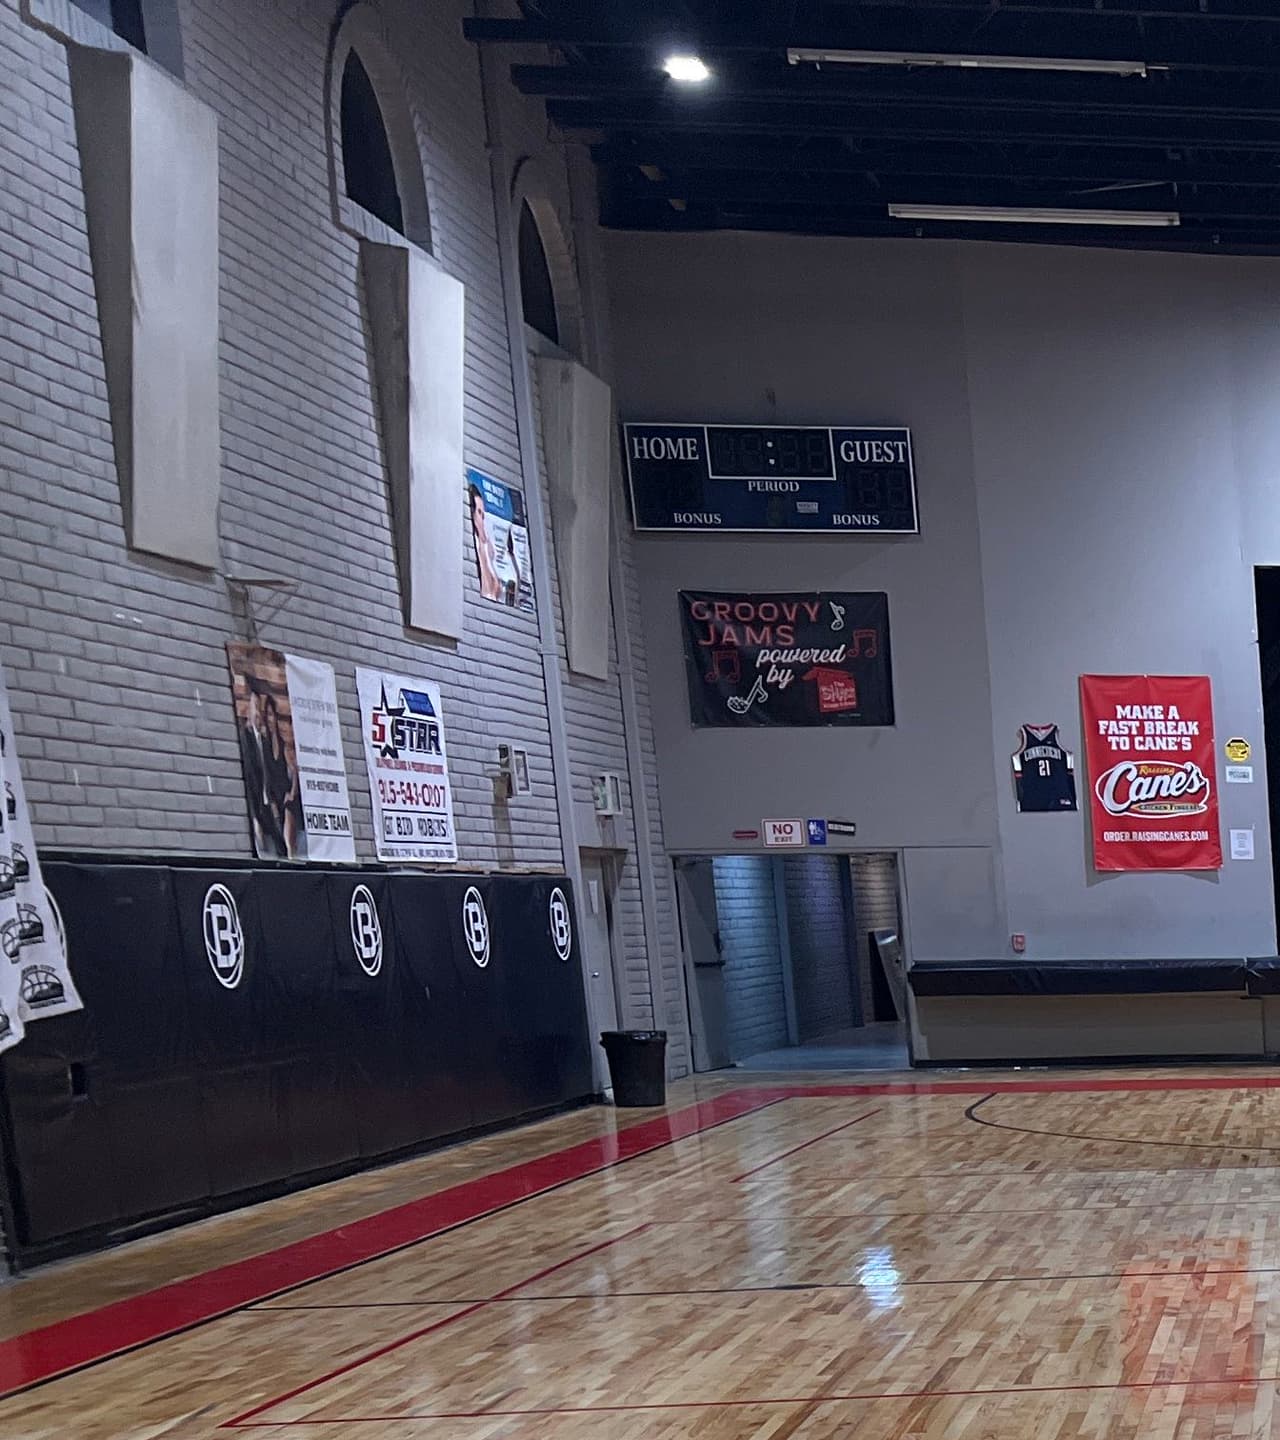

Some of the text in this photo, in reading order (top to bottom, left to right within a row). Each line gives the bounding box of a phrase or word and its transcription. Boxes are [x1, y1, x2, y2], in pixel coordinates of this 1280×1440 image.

[632, 437, 699, 460] HOME
[840, 440, 907, 463] GUEST
[748, 481, 800, 492] PERIOD
[674, 512, 722, 525] BONUS
[832, 514, 880, 526] BONUS
[690, 600, 821, 622] GROOVY
[699, 625, 795, 646] JAMS
[755, 644, 847, 668] powered
[766, 665, 794, 689] by
[1115, 705, 1180, 720] MAKE A
[372, 712, 442, 756] 5 STAR
[1098, 721, 1199, 735] FAST BREAK
[1108, 736, 1192, 750] TO CANE'S
[1038, 760, 1050, 776] 21
[1103, 761, 1206, 812] Cane's
[305, 812, 350, 831] HOME TEAM
[772, 823, 793, 835] NO
[1103, 831, 1209, 842] ORDER.RAISINGCANES.COM
